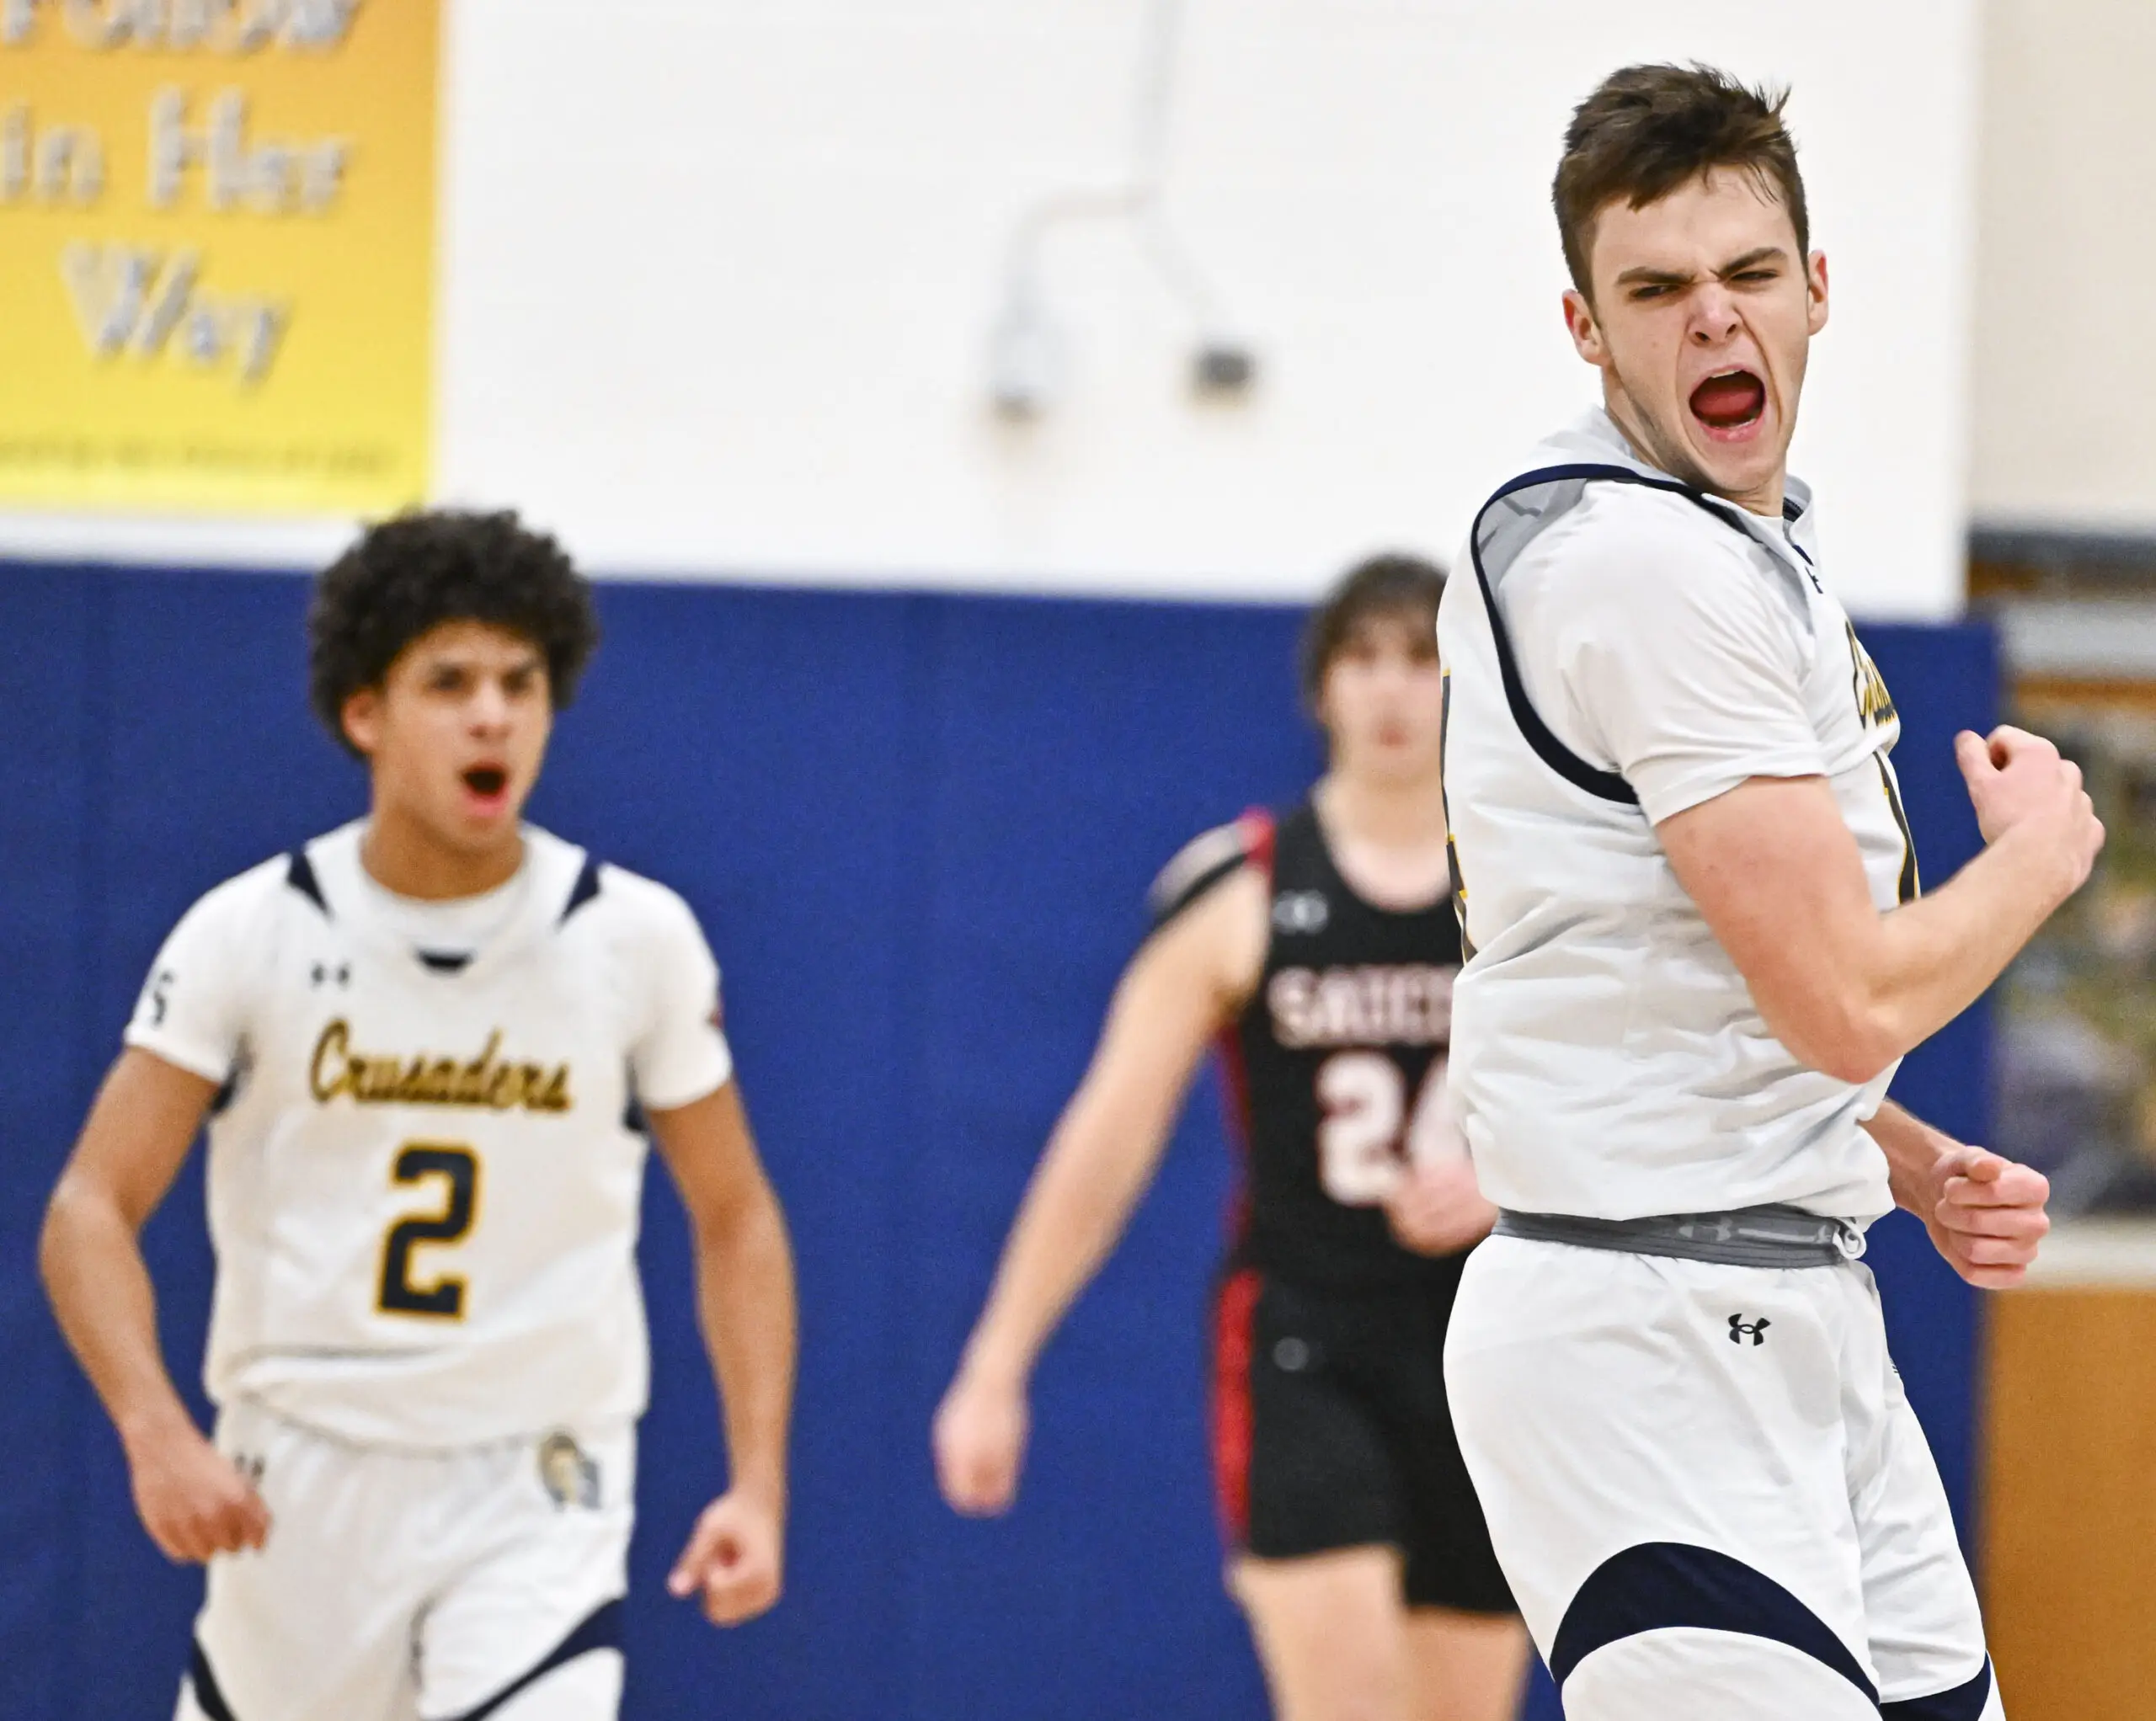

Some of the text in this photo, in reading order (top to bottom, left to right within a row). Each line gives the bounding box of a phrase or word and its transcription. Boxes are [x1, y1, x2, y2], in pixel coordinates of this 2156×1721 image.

[147, 84, 350, 217] Her
[59, 237, 294, 394] Way
[309, 1015, 574, 1115] Crusaders
[372, 1137, 484, 1323] 2
